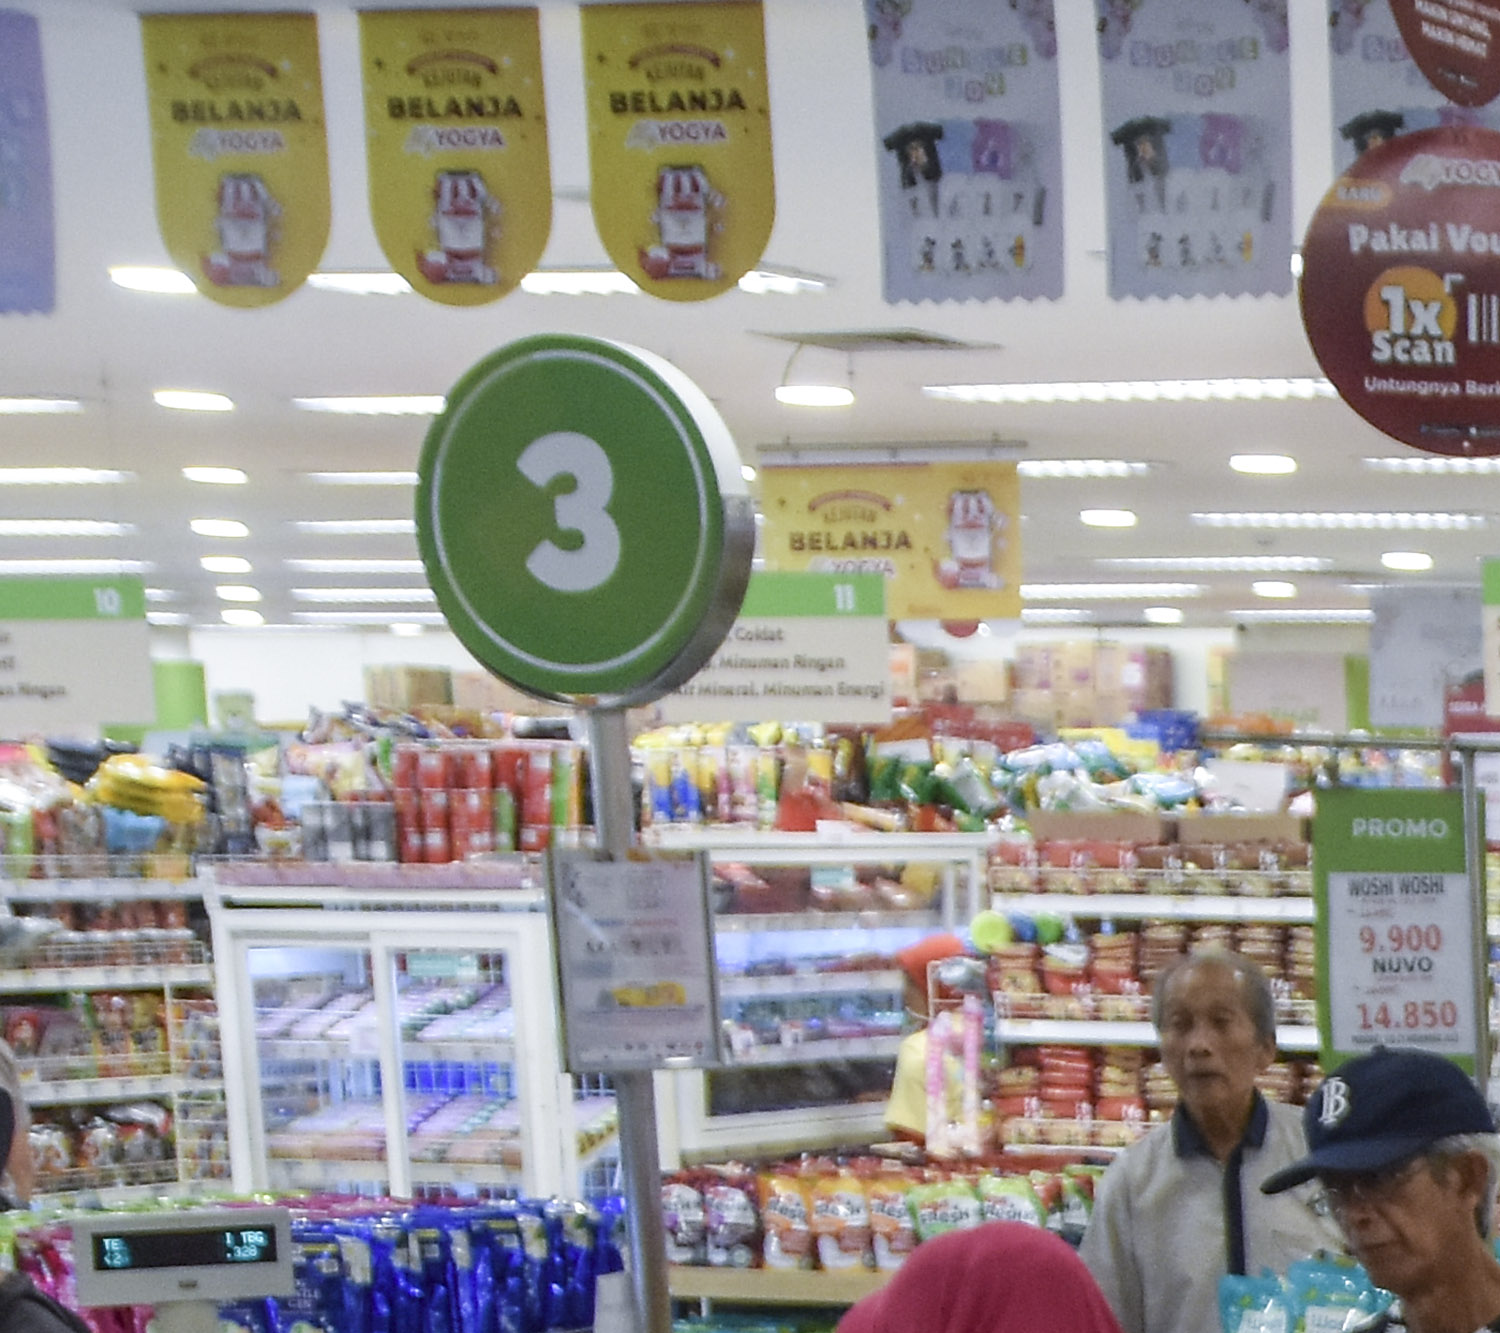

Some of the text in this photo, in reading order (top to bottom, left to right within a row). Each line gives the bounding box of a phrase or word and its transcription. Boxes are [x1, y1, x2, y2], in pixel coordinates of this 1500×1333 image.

[171, 100, 302, 123] BELANJA
[388, 97, 523, 120] BELANJA
[610, 91, 746, 113] BELANJA
[1349, 223, 1440, 254] Pakai
[1379, 285, 1443, 338] 1x
[1371, 330, 1456, 365] Scan
[515, 431, 622, 593] 3
[789, 529, 912, 552] BELANJA
[833, 583, 856, 612] 11
[1351, 817, 1449, 840] PROMO
[1348, 874, 1445, 897] WOSHI WOSHI
[1359, 923, 1443, 953] 9.900
[1372, 955, 1434, 974] NUVO
[1356, 1000, 1459, 1031] 14.850
